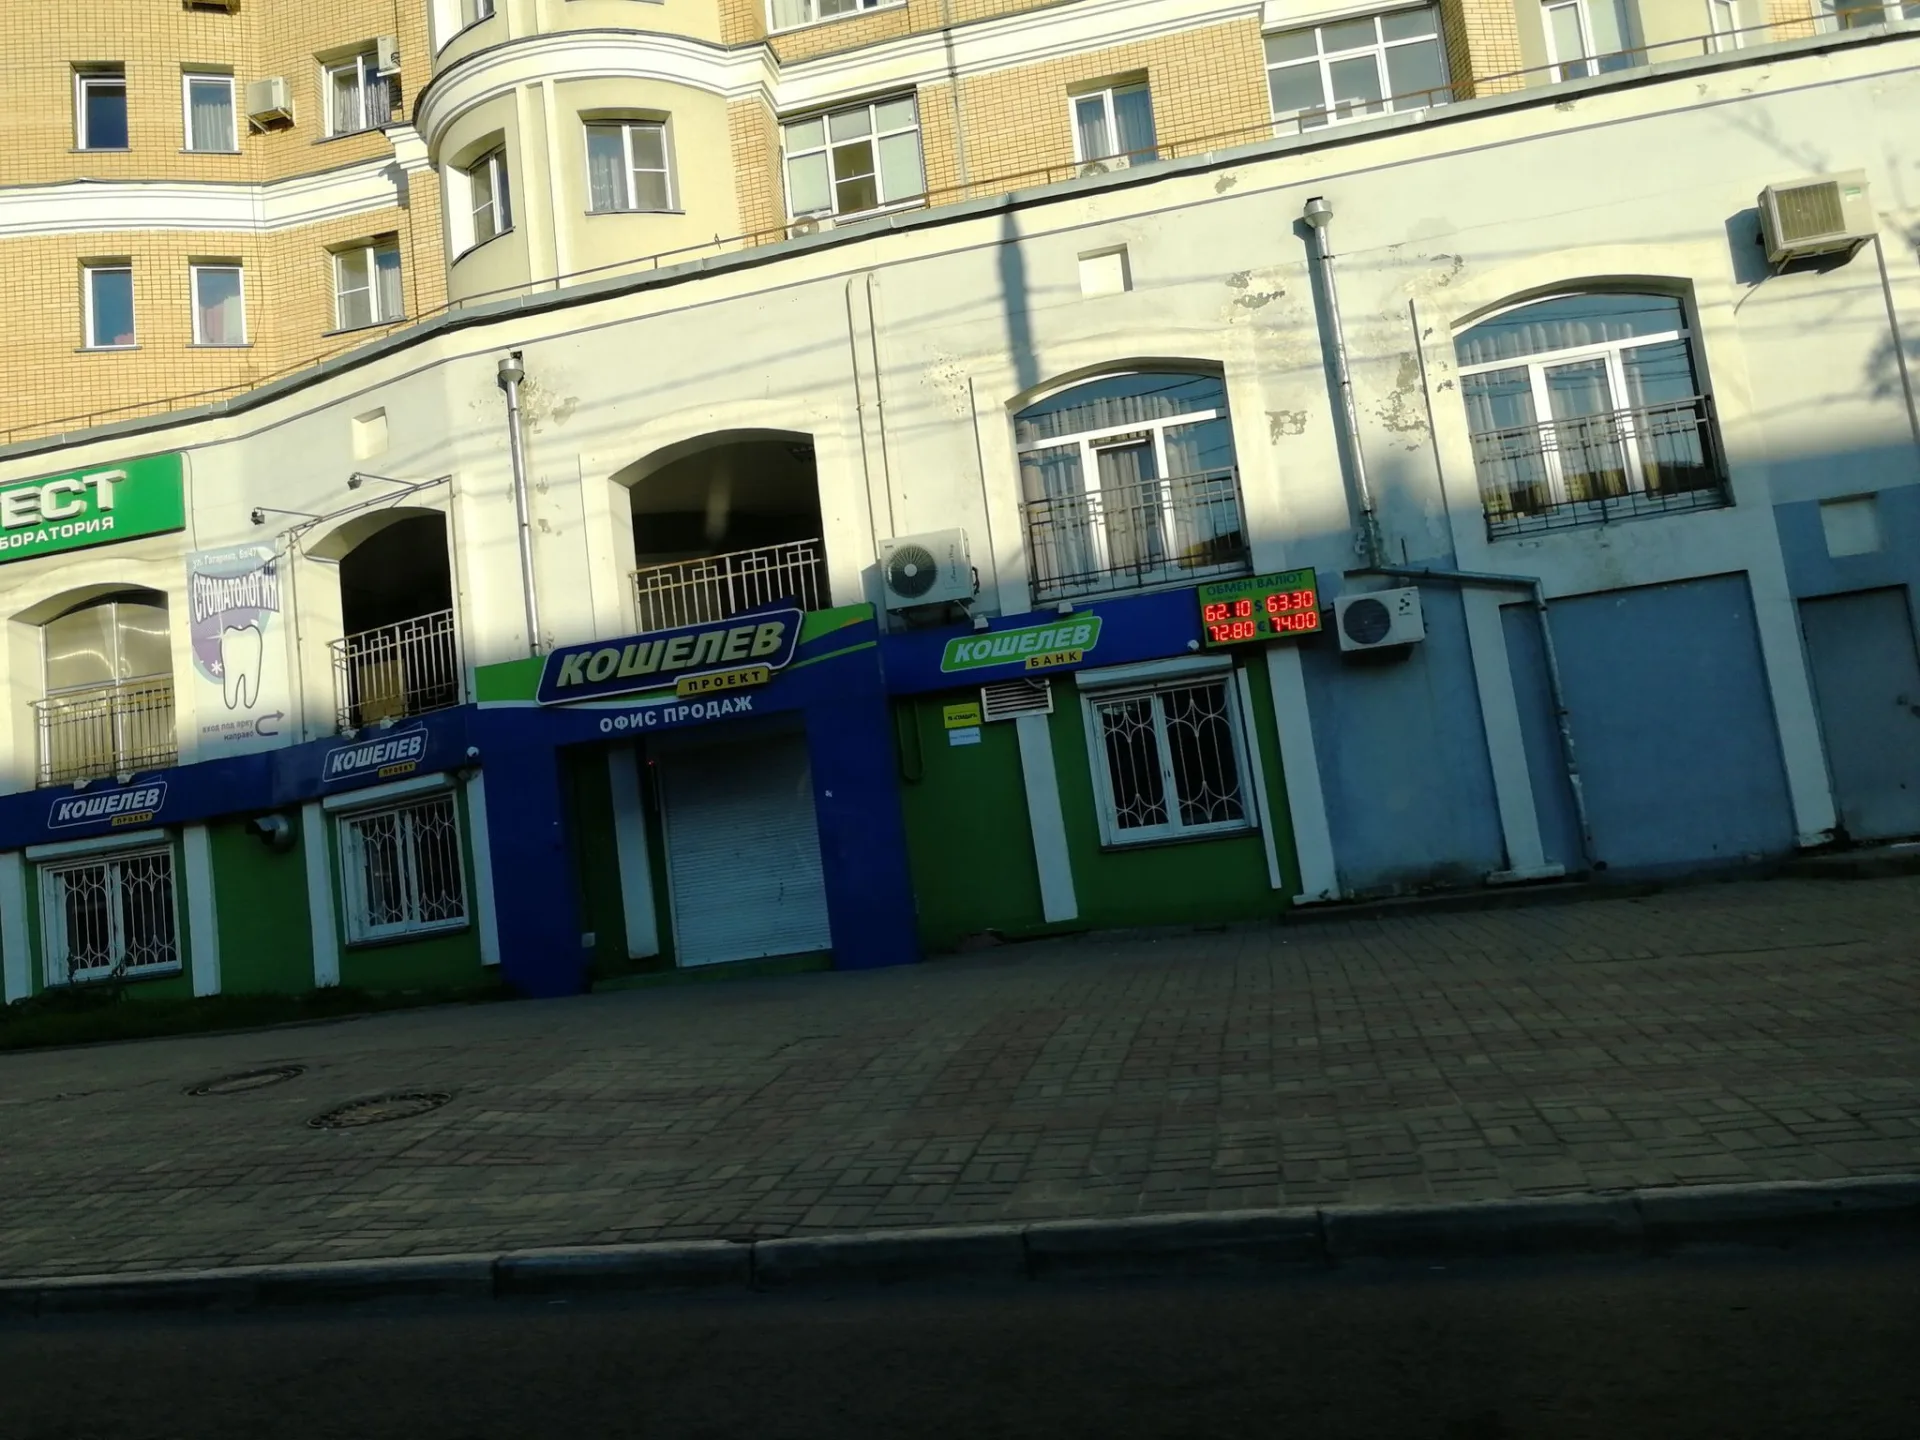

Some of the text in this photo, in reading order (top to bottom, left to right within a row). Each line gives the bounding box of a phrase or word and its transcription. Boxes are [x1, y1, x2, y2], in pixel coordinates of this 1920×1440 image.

[0, 469, 126, 530] ЕСТ
[1206, 573, 1304, 595] ОБМЕН ВАЛЮТ
[1205, 600, 1251, 622] 62.10
[1267, 591, 1313, 613] 63.30
[1209, 621, 1254, 641] 72.80
[1271, 612, 1316, 632] 74.00
[556, 621, 785, 688] КОШЕЛЕВ
[954, 624, 1092, 663] КОШЕЛЕВ
[1030, 655, 1078, 668] БАНК
[688, 670, 761, 692] ПРОЕКТ
[600, 695, 753, 733] ОФИС ПРОДАЖ
[331, 736, 422, 773] КОШЕЛЕВ
[58, 788, 160, 821] КОШЕЛЕВ
